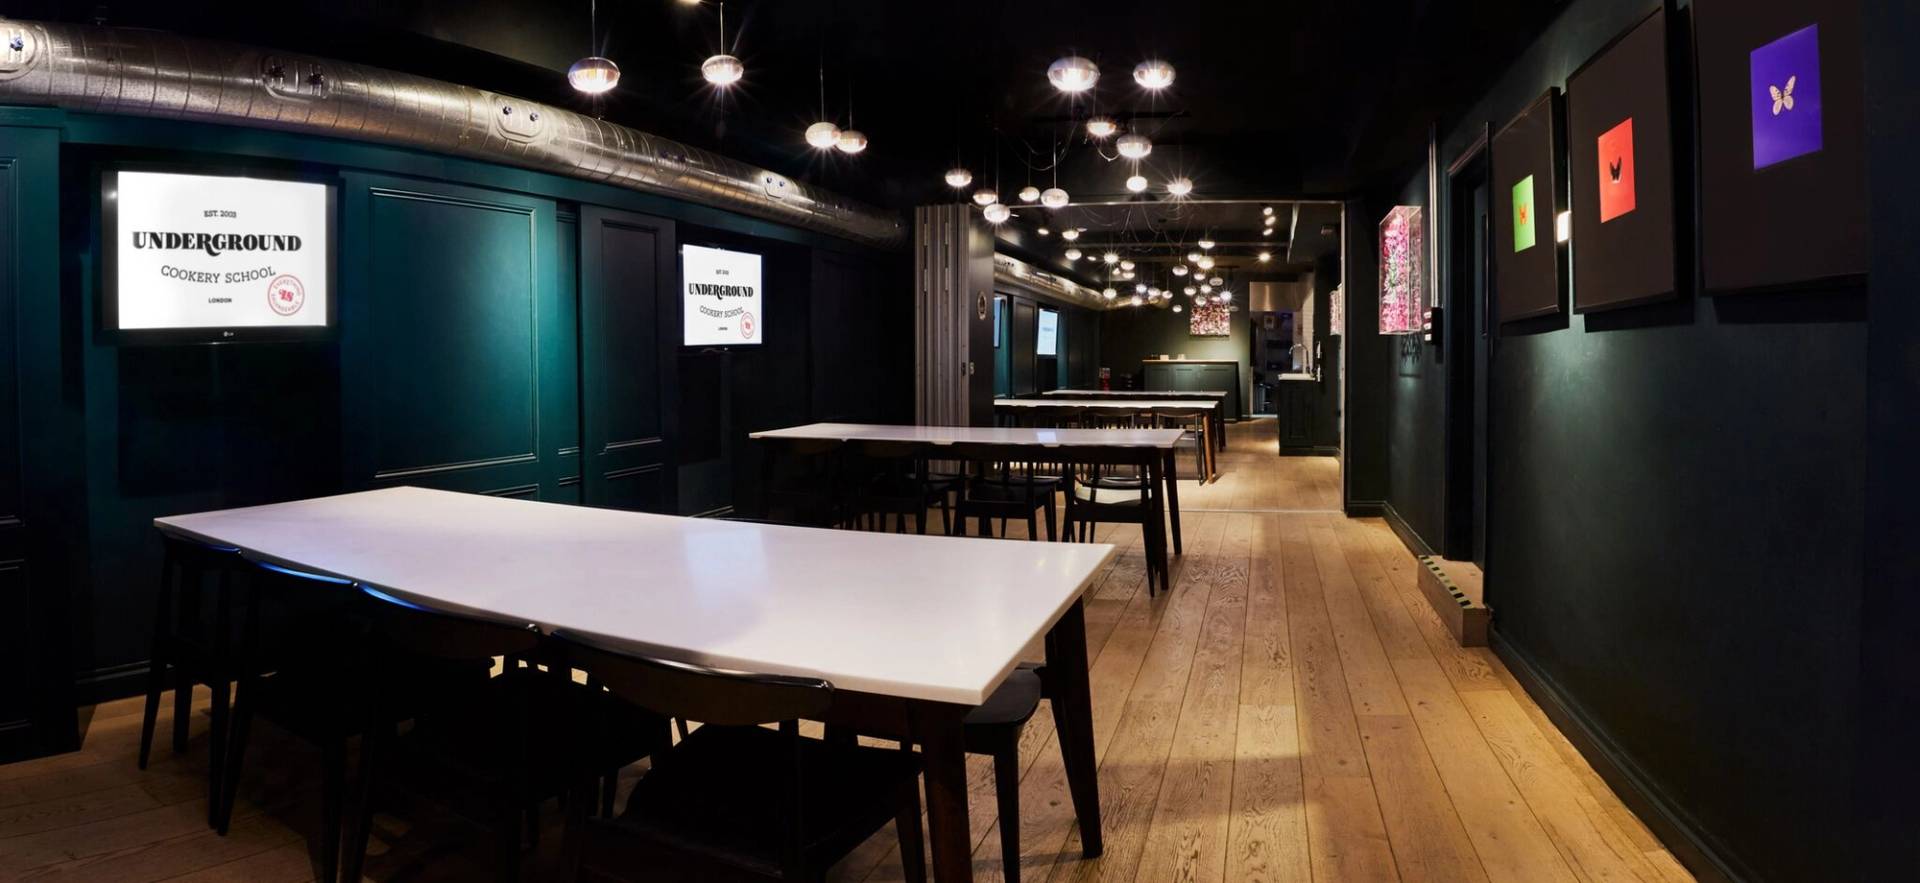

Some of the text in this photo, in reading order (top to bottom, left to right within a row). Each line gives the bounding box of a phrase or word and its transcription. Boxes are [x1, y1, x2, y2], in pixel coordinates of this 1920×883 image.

[203, 210, 219, 218] EST.
[132, 231, 302, 257] UNDERGROUND
[161, 265, 277, 284] COOKERY SCHOOL
[688, 282, 754, 300] UNDERGROUND
